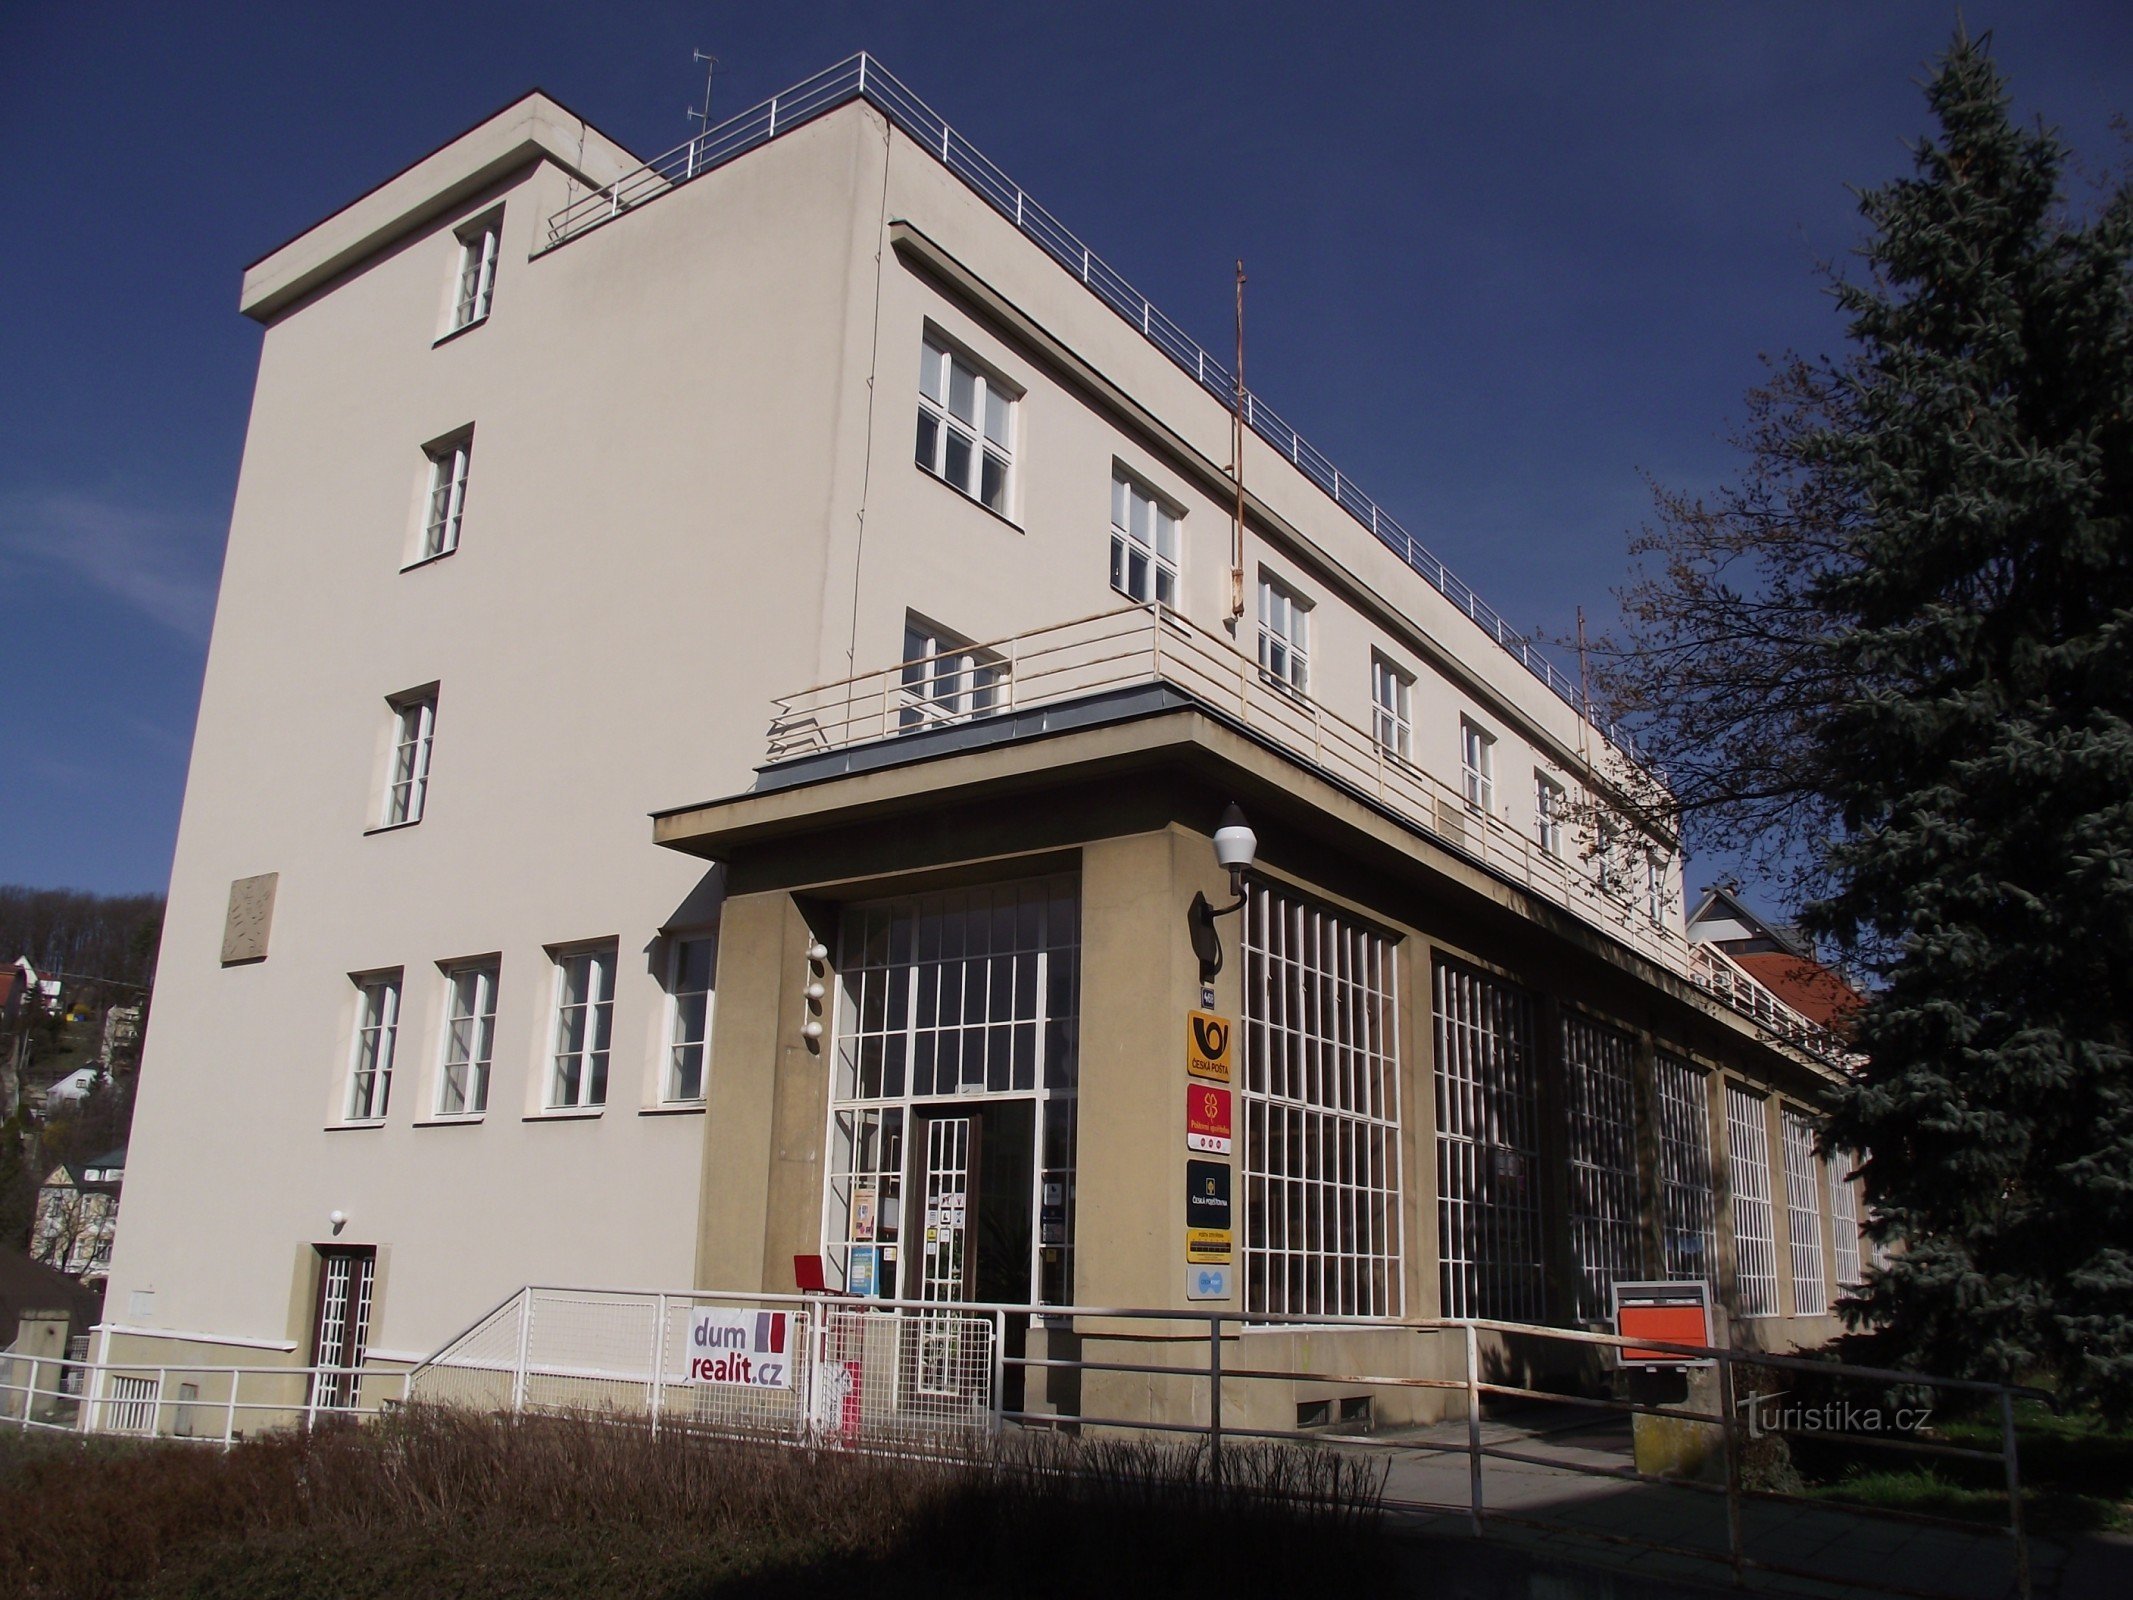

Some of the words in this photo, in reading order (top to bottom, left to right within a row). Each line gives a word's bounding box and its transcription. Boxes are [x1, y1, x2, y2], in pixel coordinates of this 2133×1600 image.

[1192, 1058, 1210, 1071] ČESKÁ
[1211, 1062, 1228, 1074] POŠTA
[694, 1316, 746, 1349] dum
[691, 1352, 783, 1386] realit.cz
